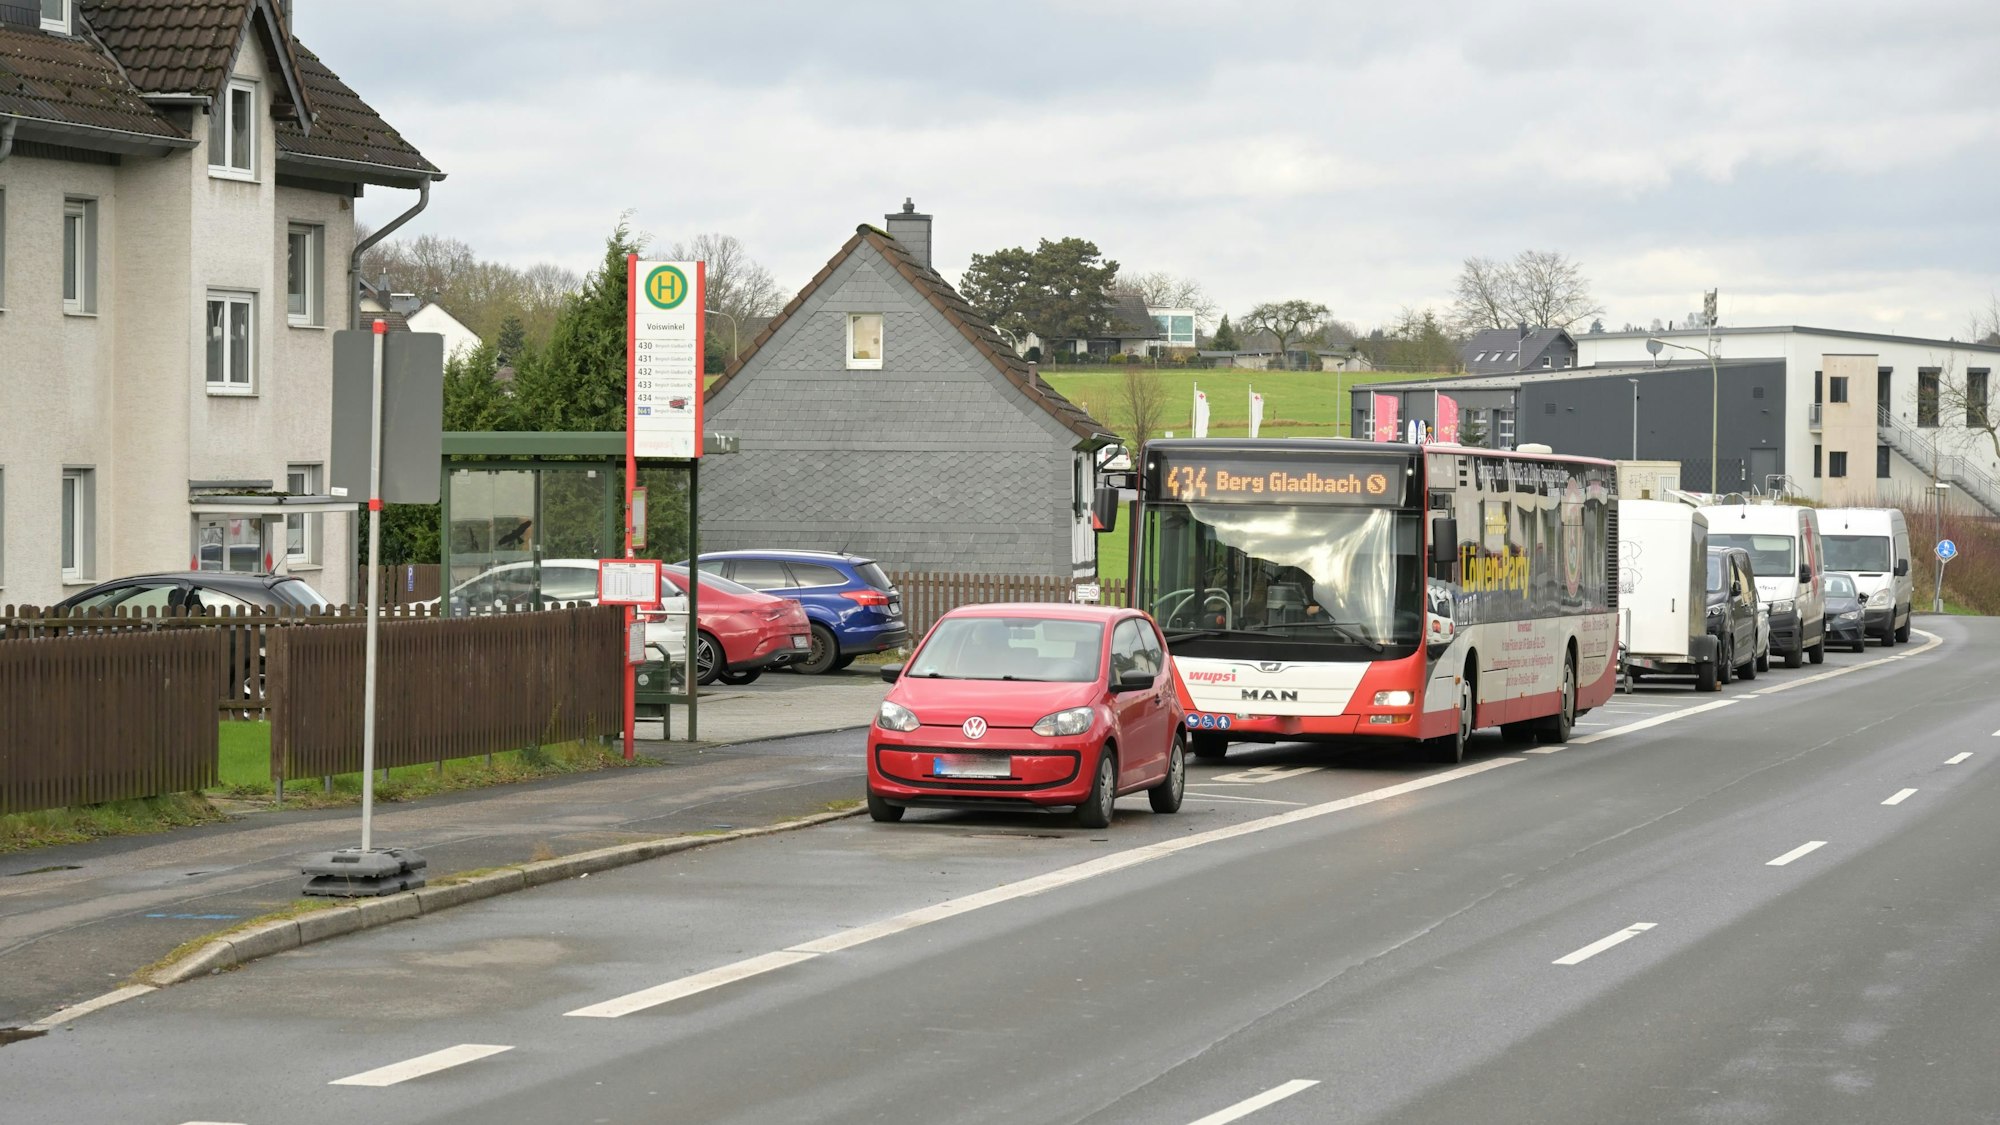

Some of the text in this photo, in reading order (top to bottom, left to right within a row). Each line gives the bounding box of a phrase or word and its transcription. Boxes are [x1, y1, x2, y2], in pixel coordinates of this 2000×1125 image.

[657, 275, 675, 300] H
[646, 323, 685, 331] Voiswinkel
[638, 342, 652, 350] 430
[638, 355, 652, 363] 431
[638, 368, 652, 376] 432
[638, 381, 652, 389] 433
[1167, 466, 1208, 497] 434
[1216, 471, 1264, 493] Berg
[1269, 472, 1361, 493] Gladbach
[1462, 545, 1530, 600] Löwen-Party
[1189, 669, 1237, 683] wupsi
[1241, 689, 1298, 701] MAN
